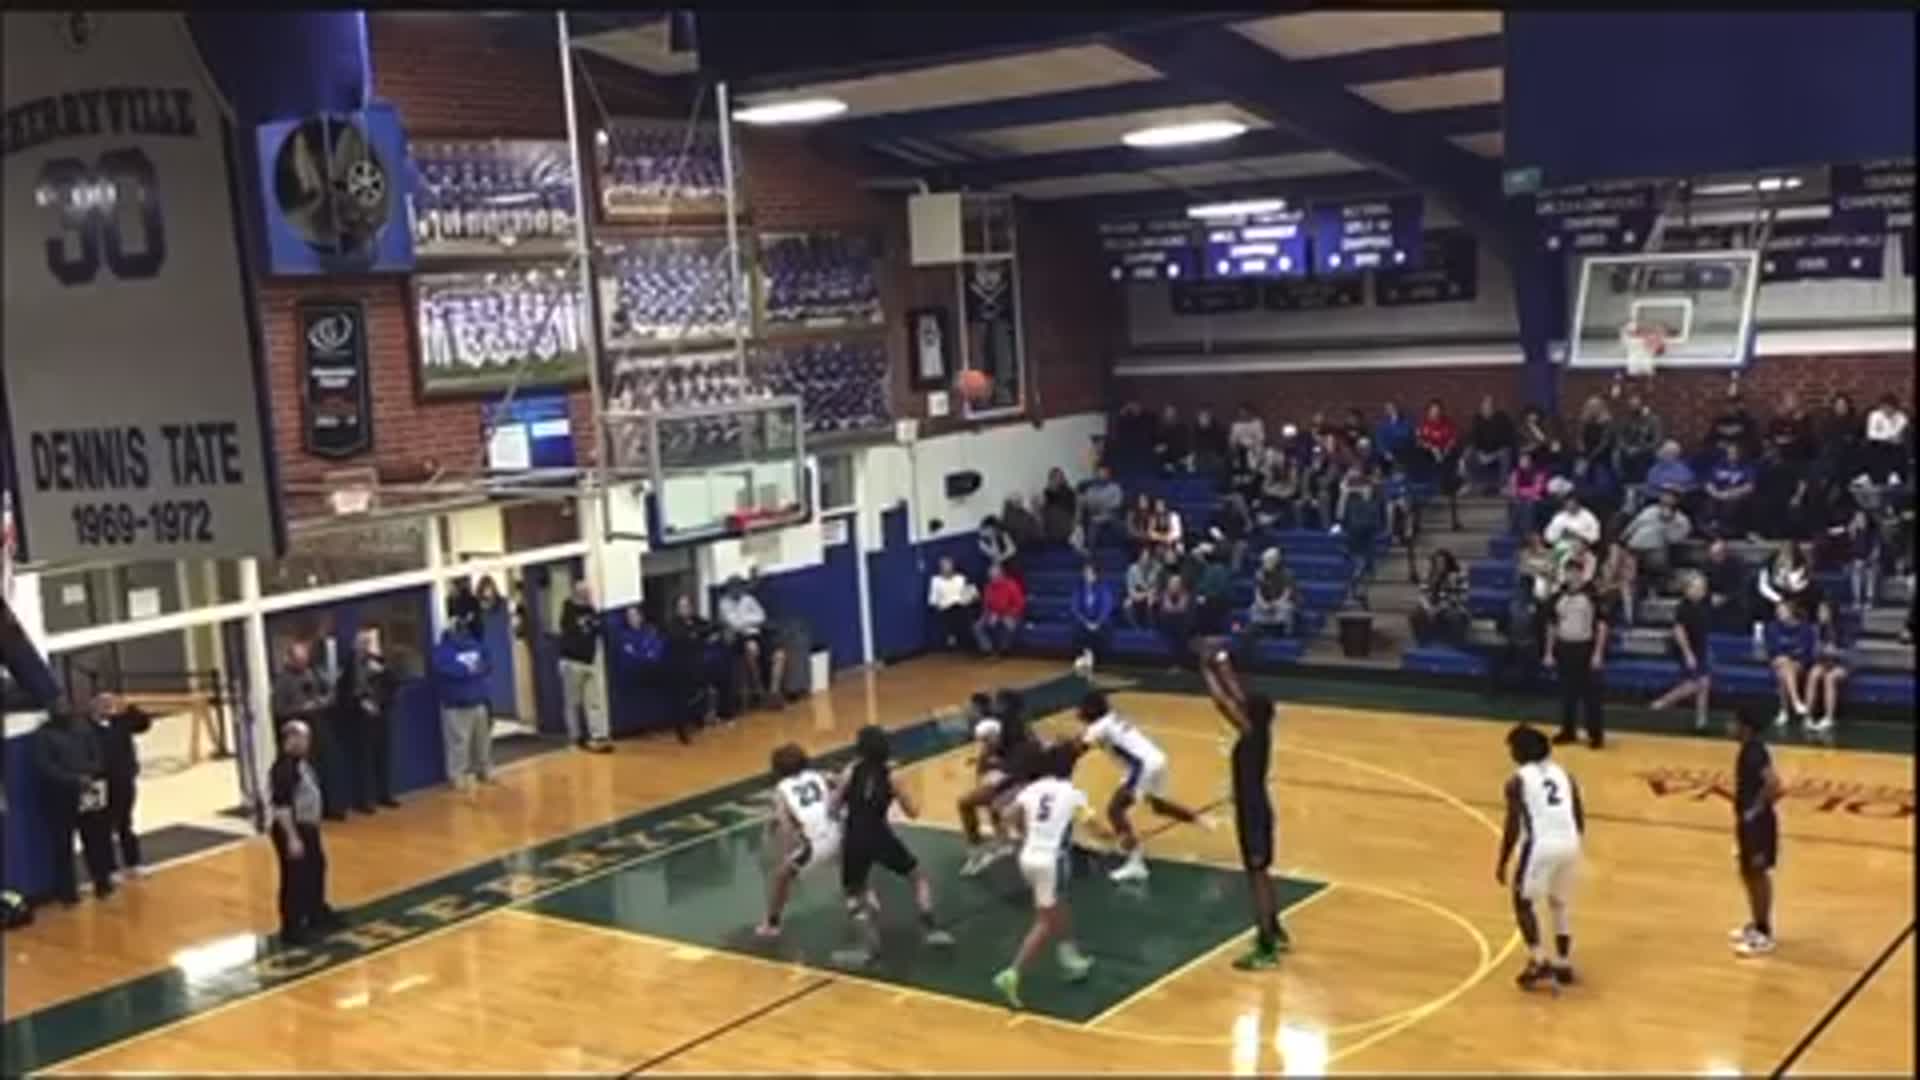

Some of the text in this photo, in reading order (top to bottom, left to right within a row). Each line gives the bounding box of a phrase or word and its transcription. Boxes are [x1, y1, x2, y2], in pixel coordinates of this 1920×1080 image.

[31, 422, 243, 491] DENNIS TATE
[72, 500, 214, 546] 1969-1972
[1036, 793, 1056, 823] 5
[1541, 778, 1563, 806] 2
